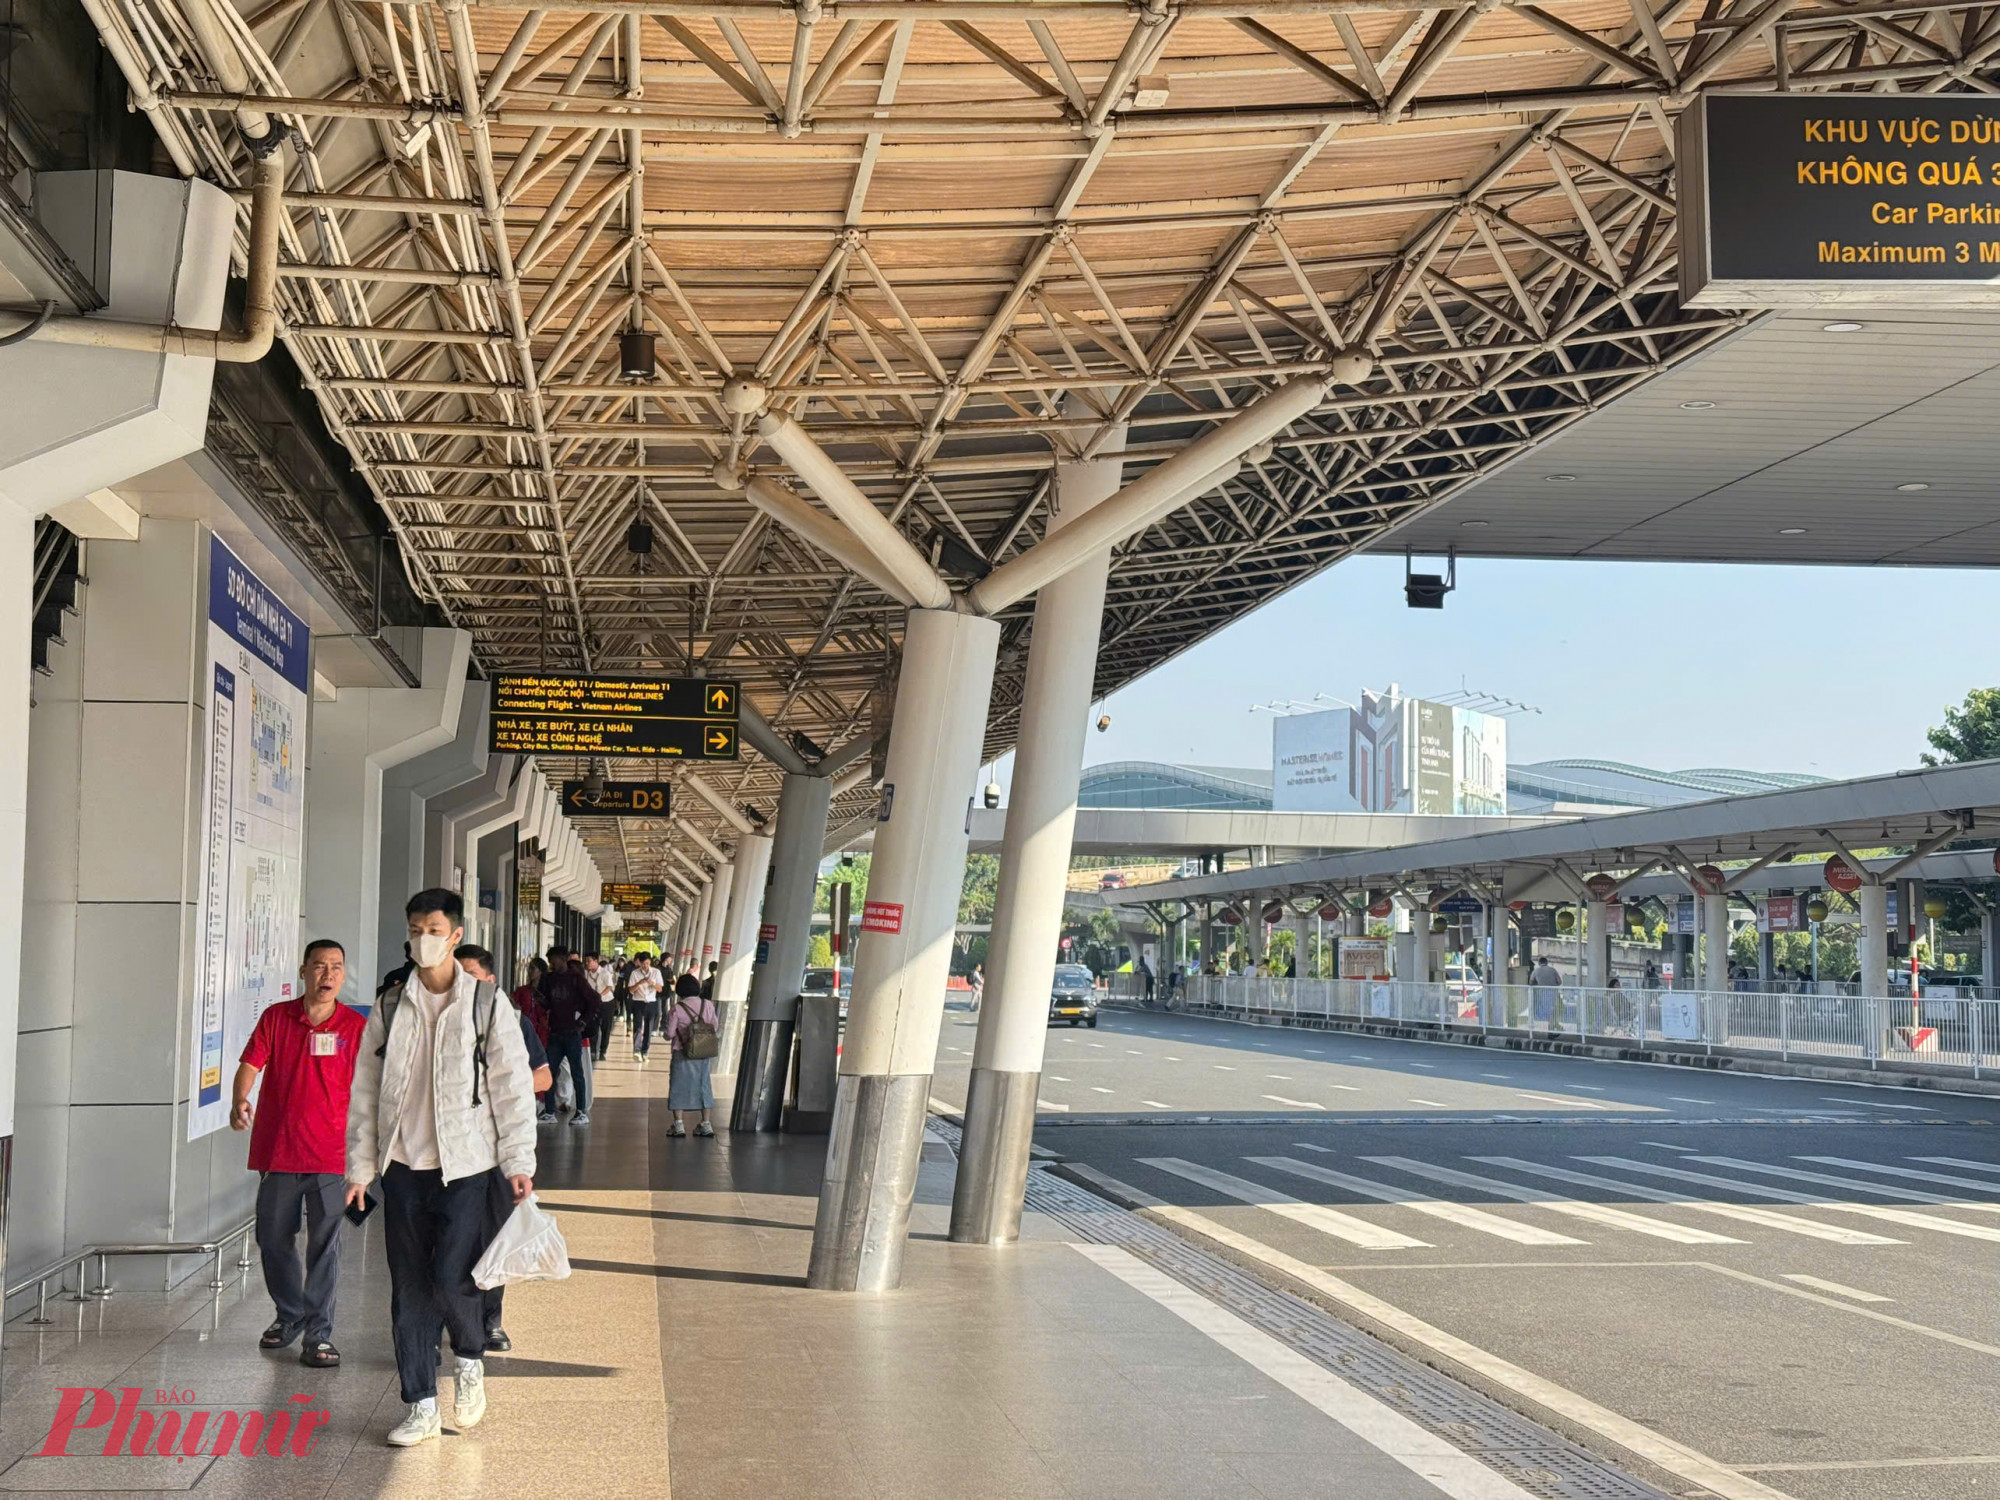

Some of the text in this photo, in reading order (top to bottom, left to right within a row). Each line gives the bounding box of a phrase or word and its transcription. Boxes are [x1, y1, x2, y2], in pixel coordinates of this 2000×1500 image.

[1805, 120, 1868, 143] KHU
[1877, 117, 1941, 148] VỰC
[1797, 155, 1908, 185] KHÔNG
[1918, 156, 1984, 186] QUÁ
[1871, 202, 1919, 224] Car
[1818, 242, 1946, 263] Maximum
[1955, 242, 1970, 263] 3
[595, 681, 628, 689] Domestic
[631, 682, 660, 690] Arrivals
[662, 683, 670, 691] T1
[591, 691, 626, 699] VIETNAM
[628, 692, 664, 700] AIRLINES
[498, 699, 546, 710] Connecting
[547, 700, 573, 710] Flight
[581, 702, 612, 711] Vietnam
[613, 703, 642, 711] Airlines
[497, 719, 517, 729] NHÀ
[536, 722, 548, 730] XE
[578, 723, 590, 731] XE
[593, 721, 604, 732] CÁ
[606, 722, 633, 732] NHÂN
[496, 732, 509, 740] XE
[511, 733, 535, 742] TAXI,
[550, 732, 575, 742] CÔNG
[577, 733, 603, 745] NGHỆ
[632, 789, 664, 810] D3
